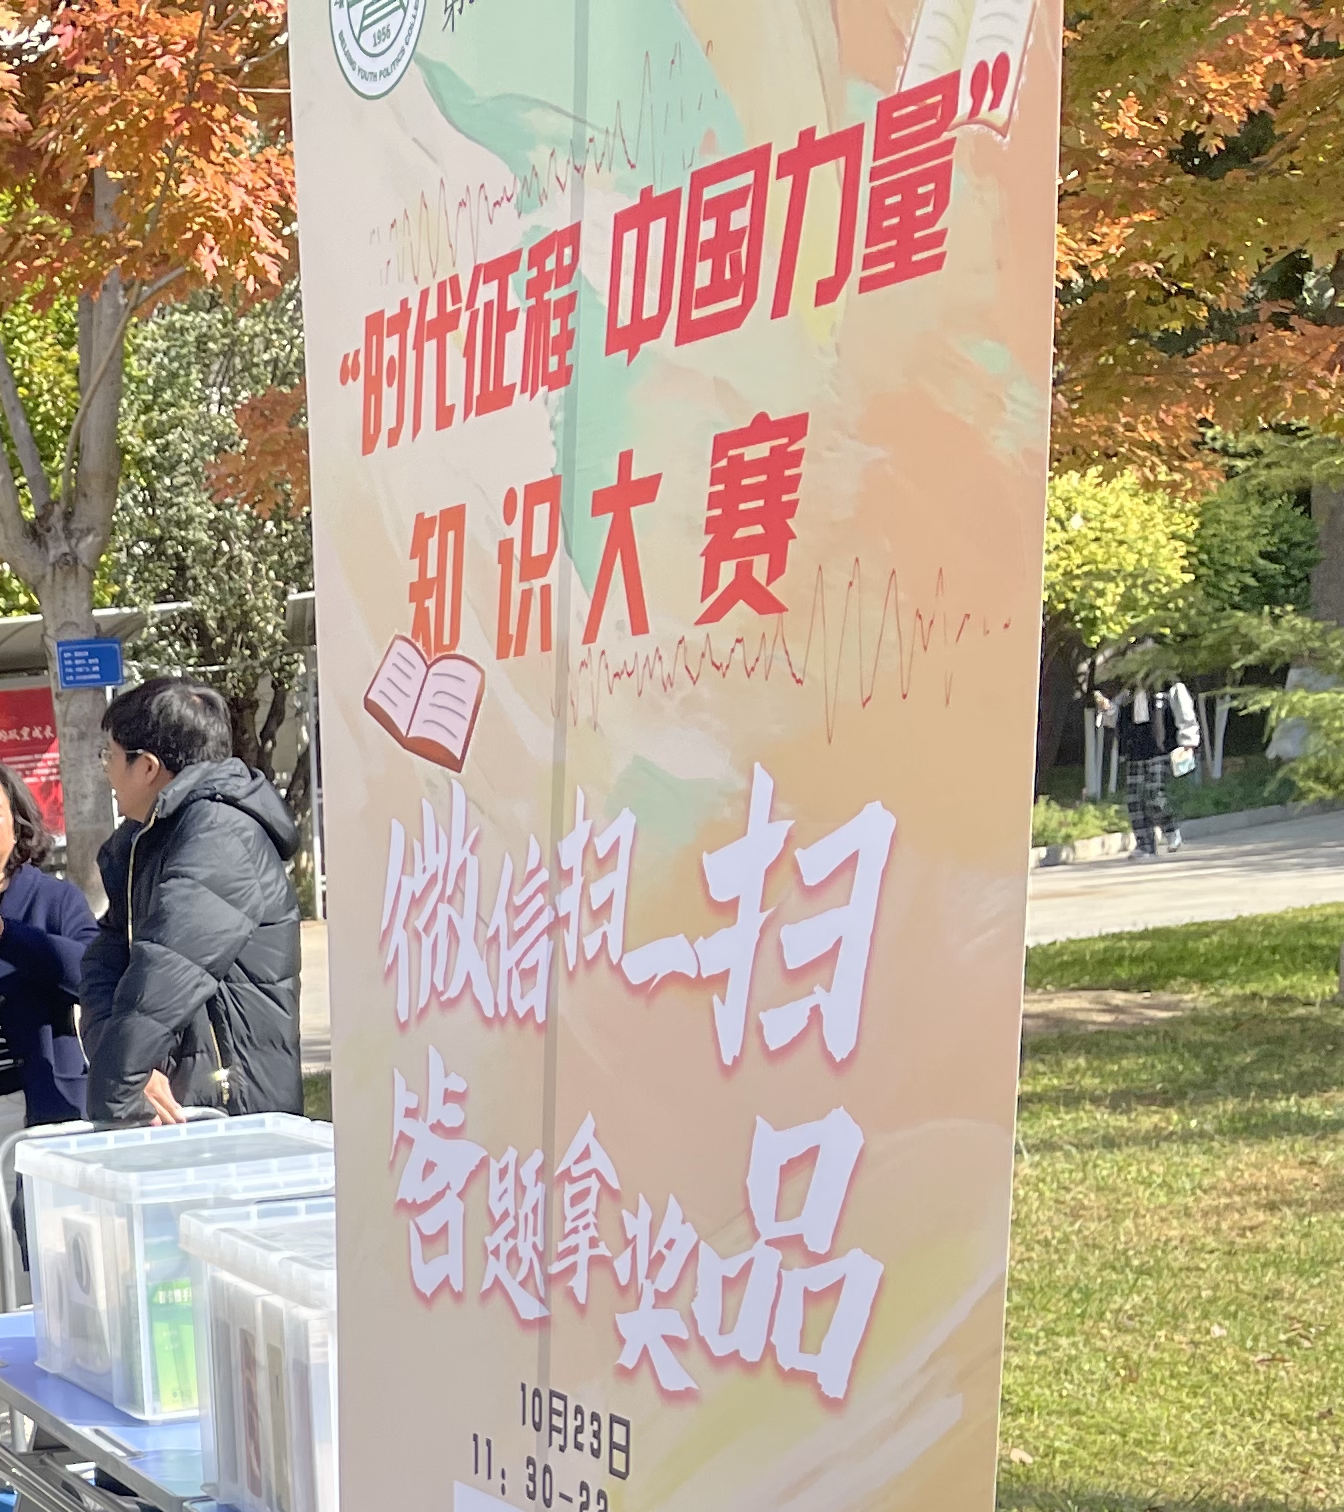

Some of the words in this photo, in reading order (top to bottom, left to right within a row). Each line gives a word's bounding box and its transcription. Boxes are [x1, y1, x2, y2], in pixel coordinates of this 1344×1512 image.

[372, 24, 392, 48] 1956
[408, 411, 809, 660] 知识大赛
[378, 761, 898, 1067] 微信扫一扫
[389, 1044, 886, 1402] 答题拿奖品
[519, 1382, 632, 1481] 10月23日
